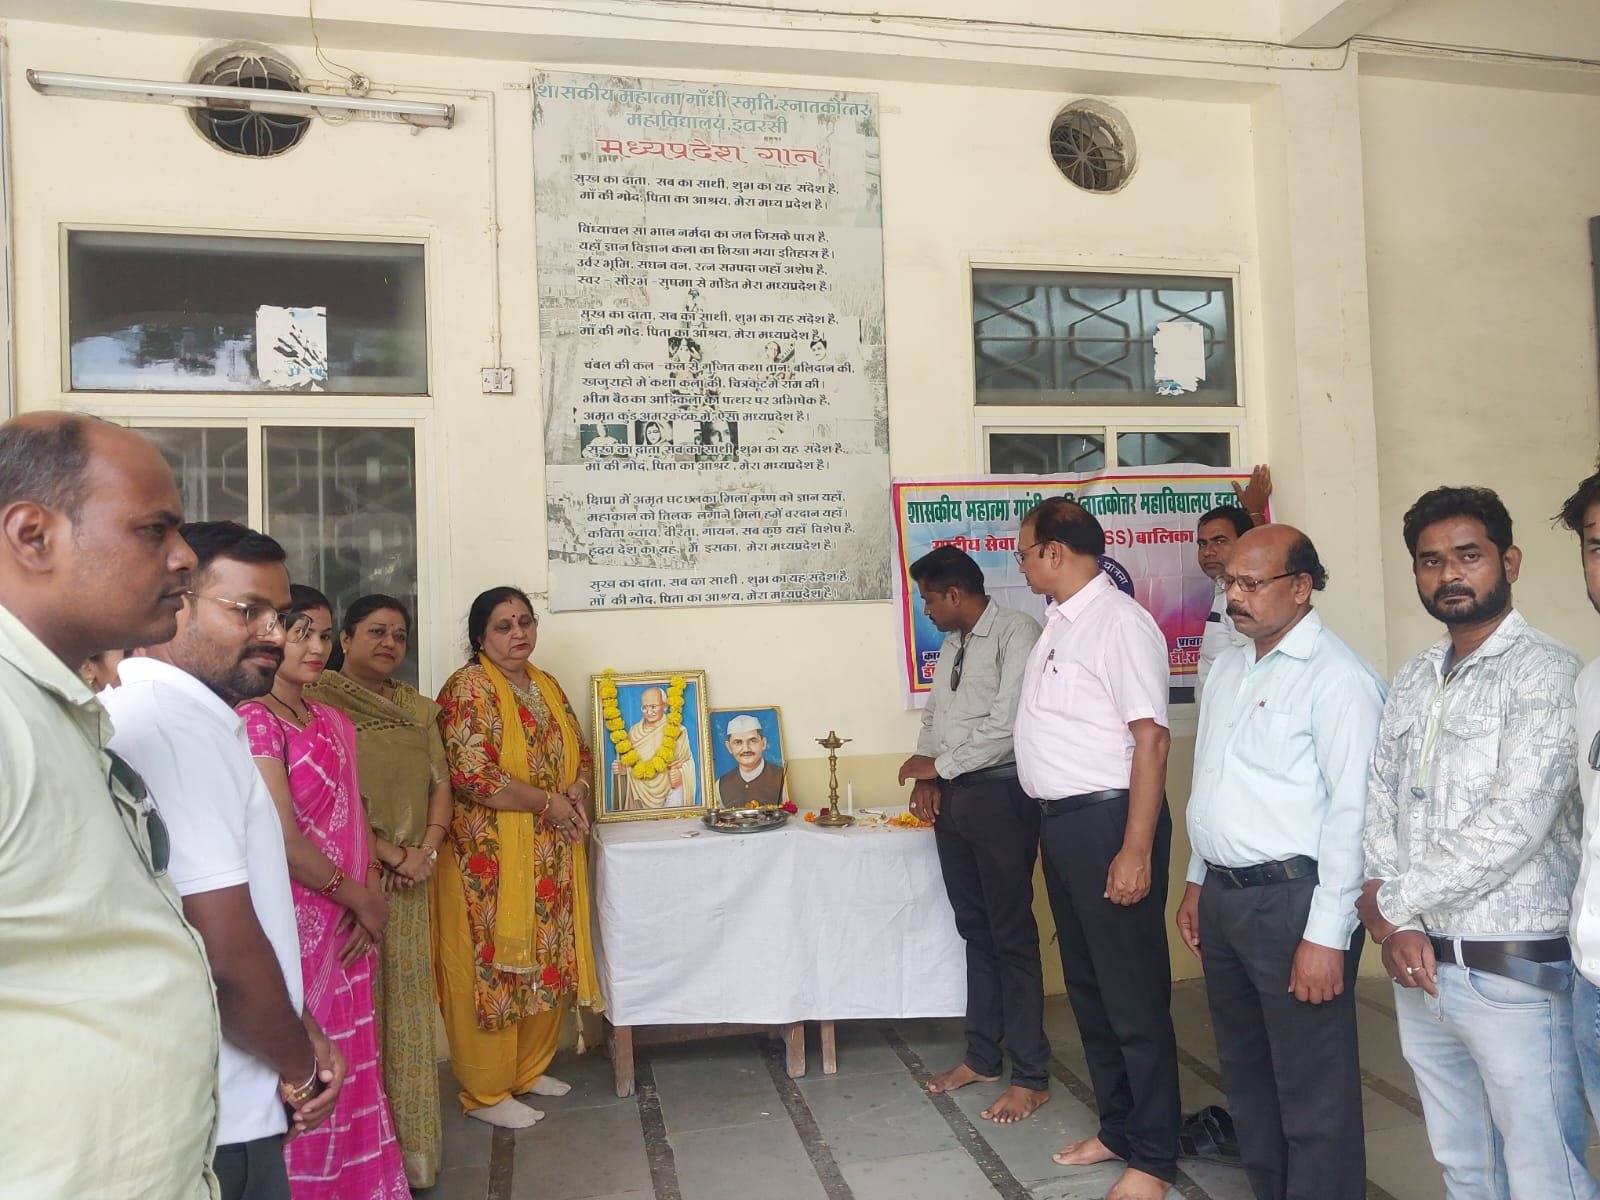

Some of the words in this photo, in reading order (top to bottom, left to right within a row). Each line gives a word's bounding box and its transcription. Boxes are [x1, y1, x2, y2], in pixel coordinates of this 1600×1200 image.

[536, 82, 613, 101] शासकीय
[618, 89, 681, 105] महात्मा
[732, 92, 774, 114] स्मृति
[596, 138, 748, 164] मध्यप्रदेश
[754, 147, 825, 168] गान
[574, 174, 600, 186] सुख
[604, 175, 619, 185] का
[656, 178, 675, 187] सब
[678, 178, 693, 188] का
[732, 181, 754, 193] शुभ
[757, 182, 772, 191] का
[775, 183, 792, 192] यह
[797, 181, 825, 194] संदेश
[580, 188, 595, 200] माँ
[598, 189, 614, 201] की
[646, 190, 671, 203] पिता
[673, 195, 689, 204] का
[734, 195, 755, 207] मेरा
[578, 222, 629, 236] विंध्याचल
[632, 227, 647, 236] सा
[650, 227, 675, 238] भाल
[678, 226, 711, 239] नर्मदा
[714, 230, 729, 239] का
[731, 230, 752, 240] जल
[754, 228, 791, 241] जिसके
[793, 233, 815, 242] पास
[578, 239, 601, 252] यहाँ
[604, 243, 629, 253] ज्ञान
[631, 241, 668, 254] विज्ञान
[671, 245, 696, 254] कला
[699, 246, 714, 255] का
[717, 244, 749, 256] लिखा
[752, 248, 775, 257] गया
[778, 246, 819, 259] इतिहास
[577, 256, 600, 268] उर्वर
[637, 260, 667, 270] सघन
[694, 262, 716, 272] रत्न
[718, 263, 756, 273] सम्पदा
[758, 262, 781, 274] जहाँ
[784, 263, 814, 275] अशेष
[576, 275, 601, 285] स्वर
[696, 277, 706, 288] से
[709, 277, 739, 289] मंडित
[741, 278, 763, 290] मेरा
[765, 280, 817, 291] मध्यप्रदेश
[580, 310, 606, 321] सुख
[608, 310, 624, 320] का
[659, 311, 678, 320] सब
[735, 314, 757, 325] शुभ
[759, 314, 774, 323] का
[777, 314, 795, 324] यह
[796, 313, 825, 325] संदेश
[580, 324, 595, 336] माँ
[598, 324, 614, 336] की
[646, 325, 671, 337] पिता
[734, 328, 755, 339] मेरा
[758, 328, 809, 340] मध्यप्रदेश
[583, 391, 610, 404] भीम
[722, 396, 752, 405] पत्थर
[754, 396, 769, 405] पर
[772, 394, 817, 405] अभिषेक
[586, 493, 616, 505] क्षिप्रा
[619, 492, 632, 505] में
[633, 495, 664, 507] अमृत
[720, 492, 747, 503] मिला
[750, 493, 777, 506] कृष्ण
[779, 491, 794, 502] को
[797, 493, 819, 502] ज्ञान
[907, 494, 962, 523] शासकीय
[965, 500, 1010, 521] महात्मा
[1140, 487, 1212, 514] महाविद्यालय
[587, 511, 637, 522] महाकाल
[640, 510, 655, 521] को
[658, 509, 693, 520] तिलक
[696, 508, 731, 520] लगाने
[733, 508, 761, 519] मिला
[764, 507, 784, 519] हमें
[784, 509, 820, 519] वरदान
[587, 527, 625, 538] कविता
[741, 527, 759, 536] सब
[762, 527, 782, 538] कुछ
[785, 523, 808, 534] यहाँ
[811, 522, 842, 534] विशेष
[985, 534, 1017, 551] सेवा
[1136, 528, 1194, 545] बालिका
[590, 580, 616, 592] सुख
[619, 579, 635, 588] का
[669, 578, 688, 587] सब
[690, 577, 706, 586] का
[747, 575, 769, 587] शुभ
[771, 575, 786, 583] का
[788, 574, 806, 583] यह
[808, 571, 837, 582] संदेश
[590, 594, 605, 606] माँ
[611, 593, 627, 605] की
[659, 592, 684, 604] पिता
[686, 594, 702, 603] का
[746, 589, 768, 601] मेरा
[770, 588, 821, 600] मध्यप्रदेश
